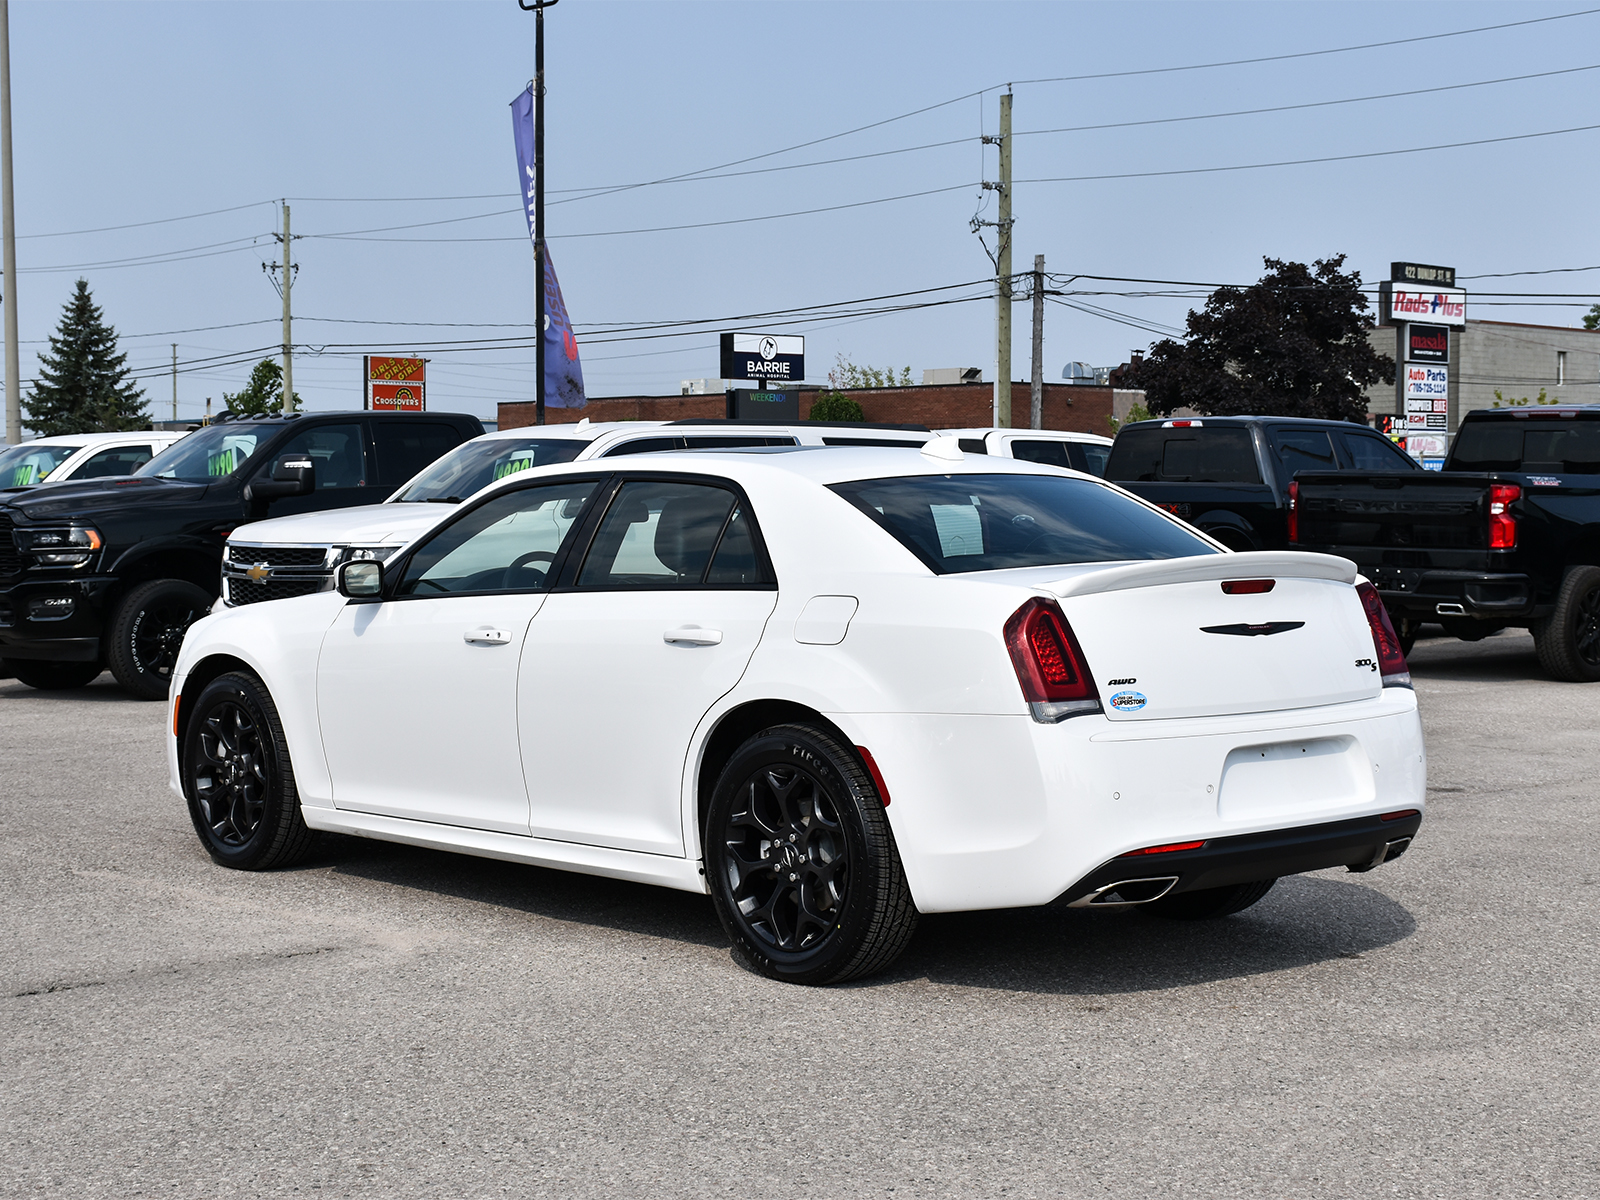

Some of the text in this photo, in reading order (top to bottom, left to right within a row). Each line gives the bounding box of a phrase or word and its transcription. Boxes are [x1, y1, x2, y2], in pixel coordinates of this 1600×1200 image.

[1405, 266, 1416, 279] 422
[1394, 290, 1430, 314] Rads
[370, 357, 396, 379] GIRLS
[384, 358, 409, 380] GIRLS
[398, 358, 423, 380] GIRLS
[747, 360, 790, 374] BARRIE
[1408, 368, 1446, 381] Auto Parts
[750, 393, 786, 402] WEEKEND!
[1409, 415, 1425, 423] EGM
[1107, 678, 1137, 686] AWD
[1113, 699, 1146, 707] SUPERSTORE
